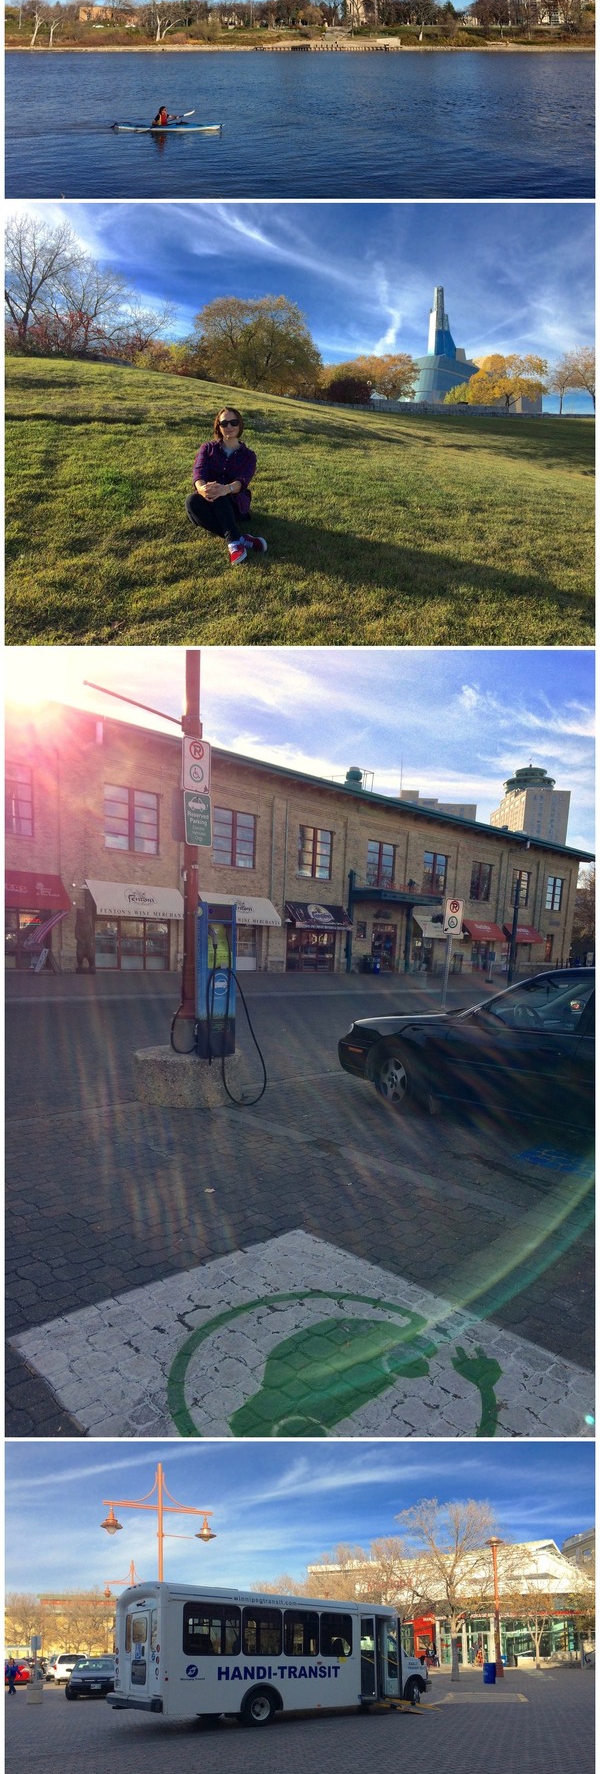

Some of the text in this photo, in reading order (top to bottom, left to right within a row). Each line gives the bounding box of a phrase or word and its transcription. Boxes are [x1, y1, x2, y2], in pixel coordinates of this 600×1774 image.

[187, 811, 209, 819] Reserved
[189, 818, 208, 826] Parking
[233, 1596, 297, 1606] winnipegtransit.com
[217, 1665, 341, 1681] HANDI-TRANSIT
